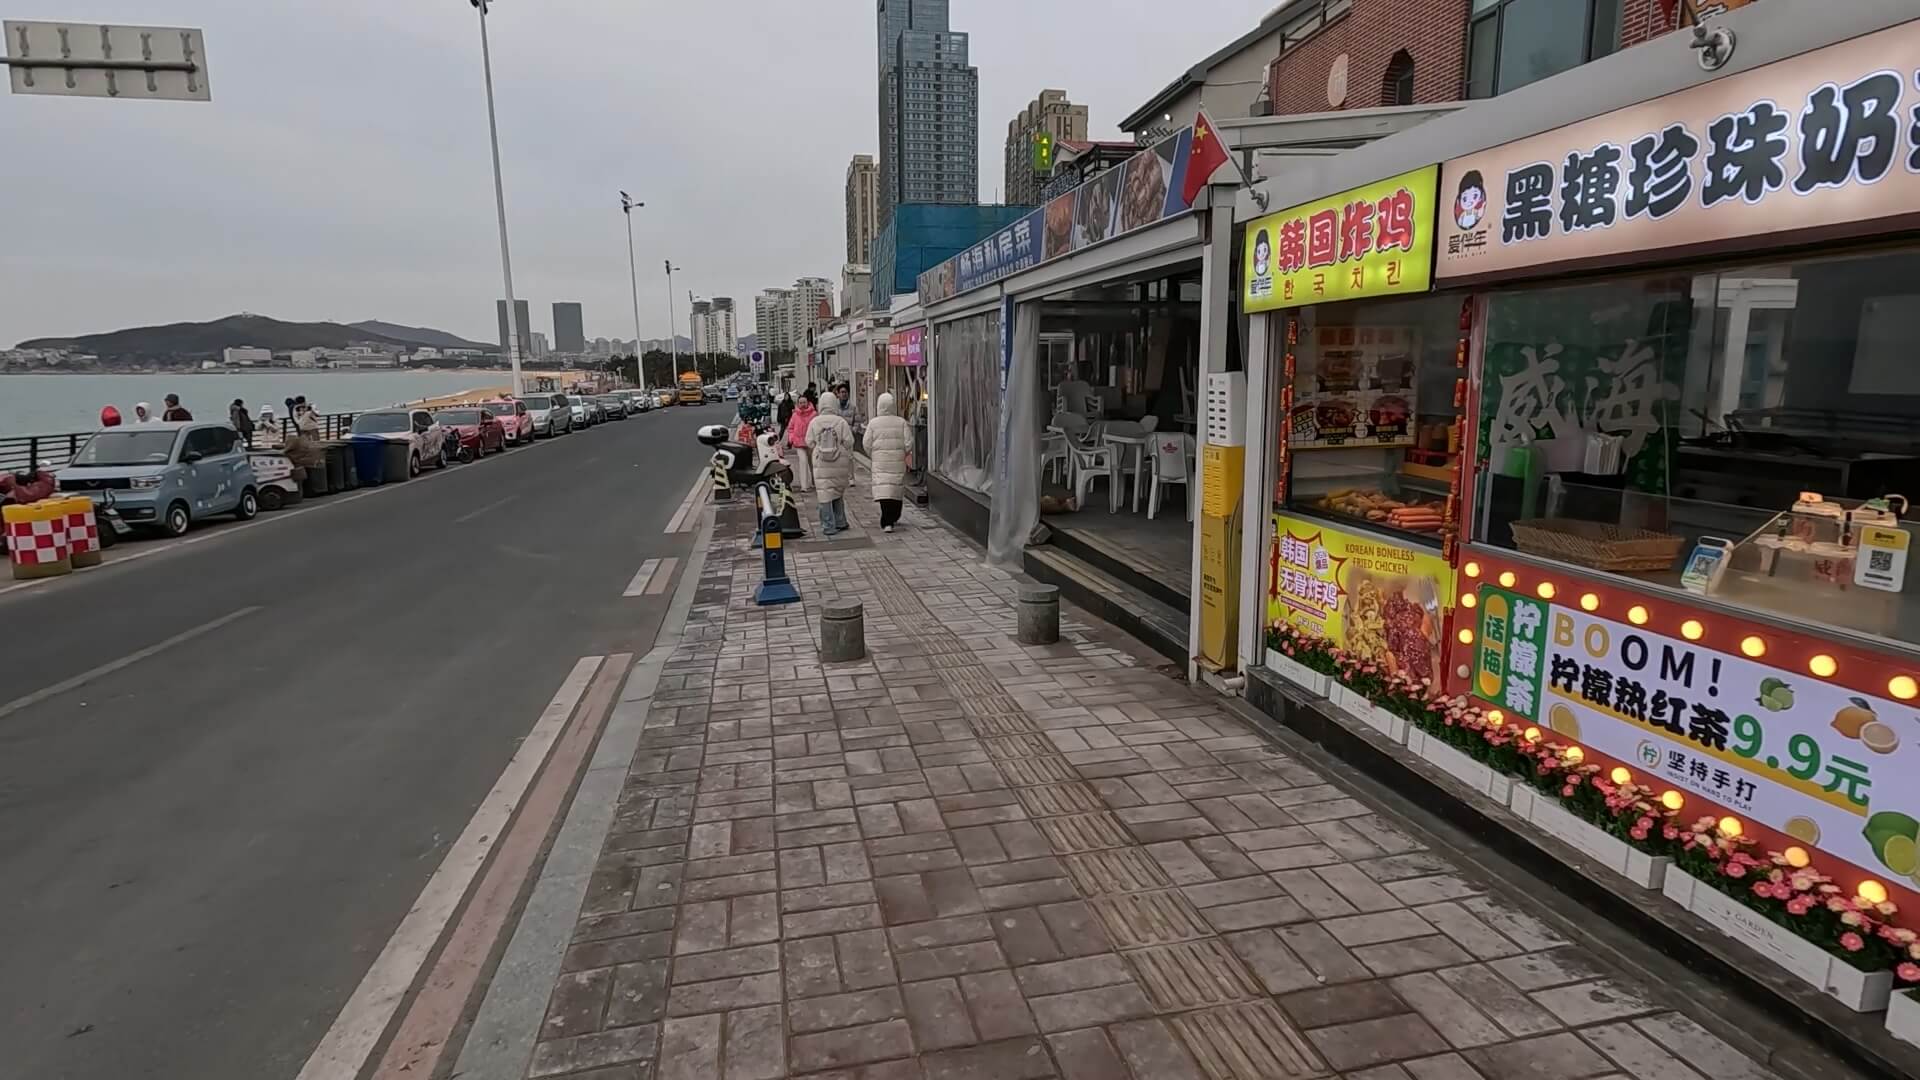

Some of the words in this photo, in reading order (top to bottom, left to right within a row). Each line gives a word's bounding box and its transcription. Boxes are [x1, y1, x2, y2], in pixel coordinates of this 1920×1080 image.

[1501, 69, 1920, 246] 黑糖珍珠奶
[1278, 186, 1414, 275] 韩国炸鸡
[1280, 535, 1310, 568] 韩国
[1345, 543, 1375, 558] KOREAN
[1376, 548, 1415, 562] BONELESS
[1352, 557, 1373, 570] FRIED
[1375, 561, 1408, 574] CHICKEN
[1279, 567, 1339, 610] 无骨炸鸡
[1483, 614, 1504, 676] 话梅
[1505, 599, 1542, 716] 柠檬茶
[1553, 612, 1722, 698] BOOM!
[1667, 749, 1758, 802] 坚持手打
